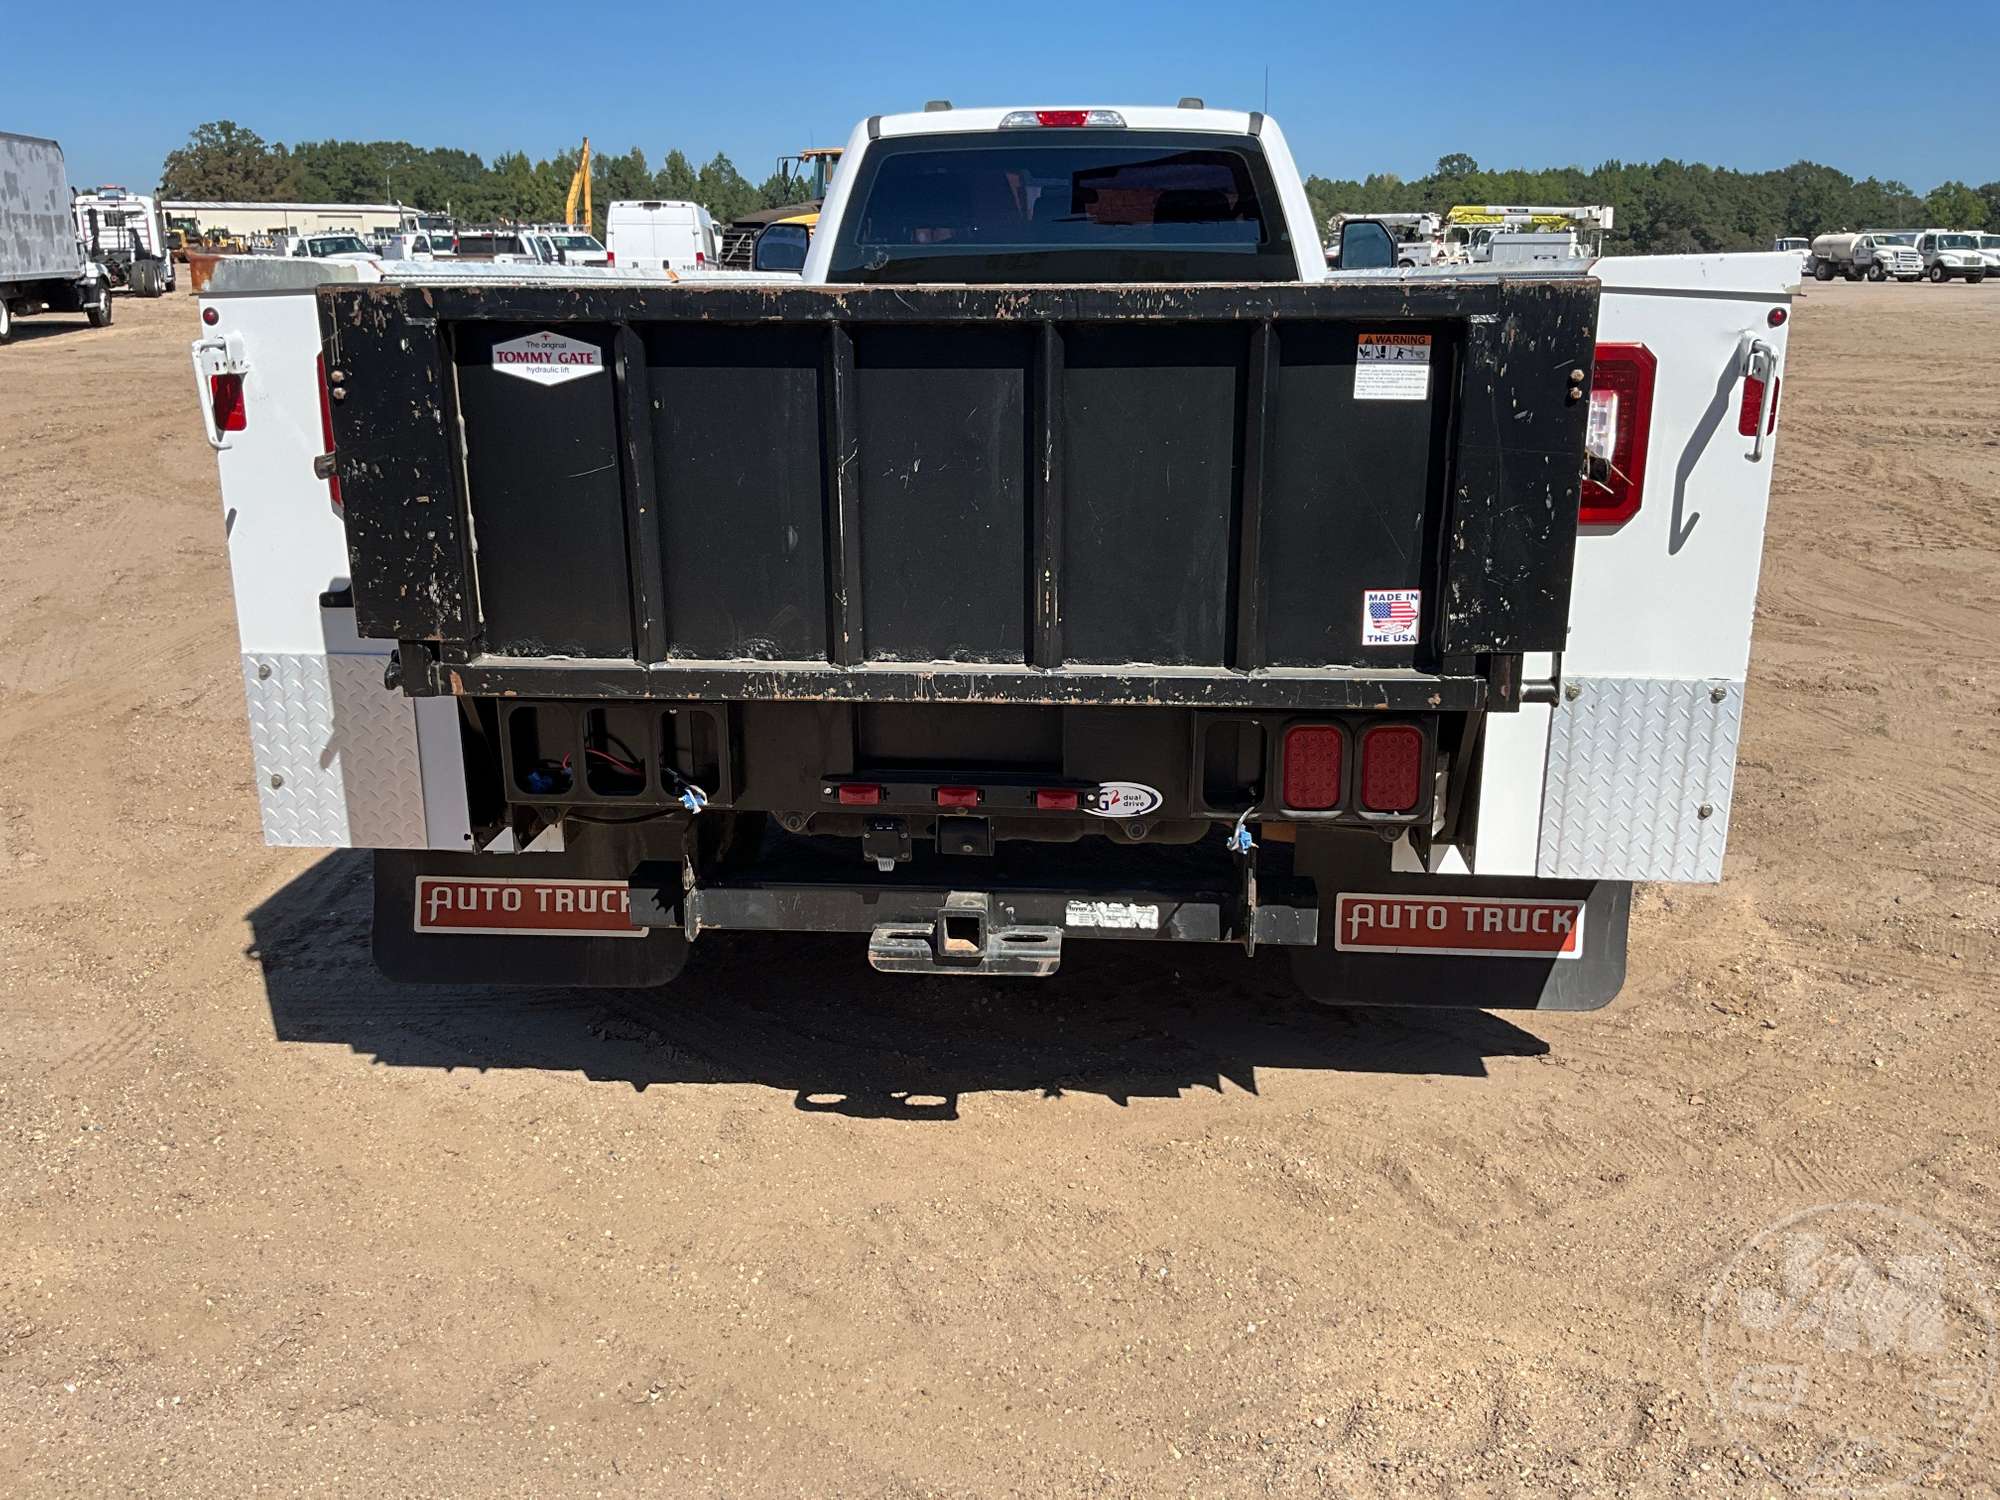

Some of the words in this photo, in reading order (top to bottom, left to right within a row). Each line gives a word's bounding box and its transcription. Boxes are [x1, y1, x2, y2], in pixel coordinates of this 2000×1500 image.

[1375, 335, 1426, 345] WARNING
[526, 341, 540, 349] The
[541, 341, 567, 350] original
[497, 351, 553, 364] TOMMY
[526, 365, 559, 375] hydraulic
[560, 366, 570, 374] lift
[1368, 593, 1402, 602] MADE
[1406, 593, 1418, 601] IN
[1367, 634, 1389, 643] THE
[1393, 634, 1417, 642] USA
[425, 886, 522, 922] AUTO
[1347, 903, 1448, 941] AUTO
[1461, 906, 1573, 934] TRUCK
